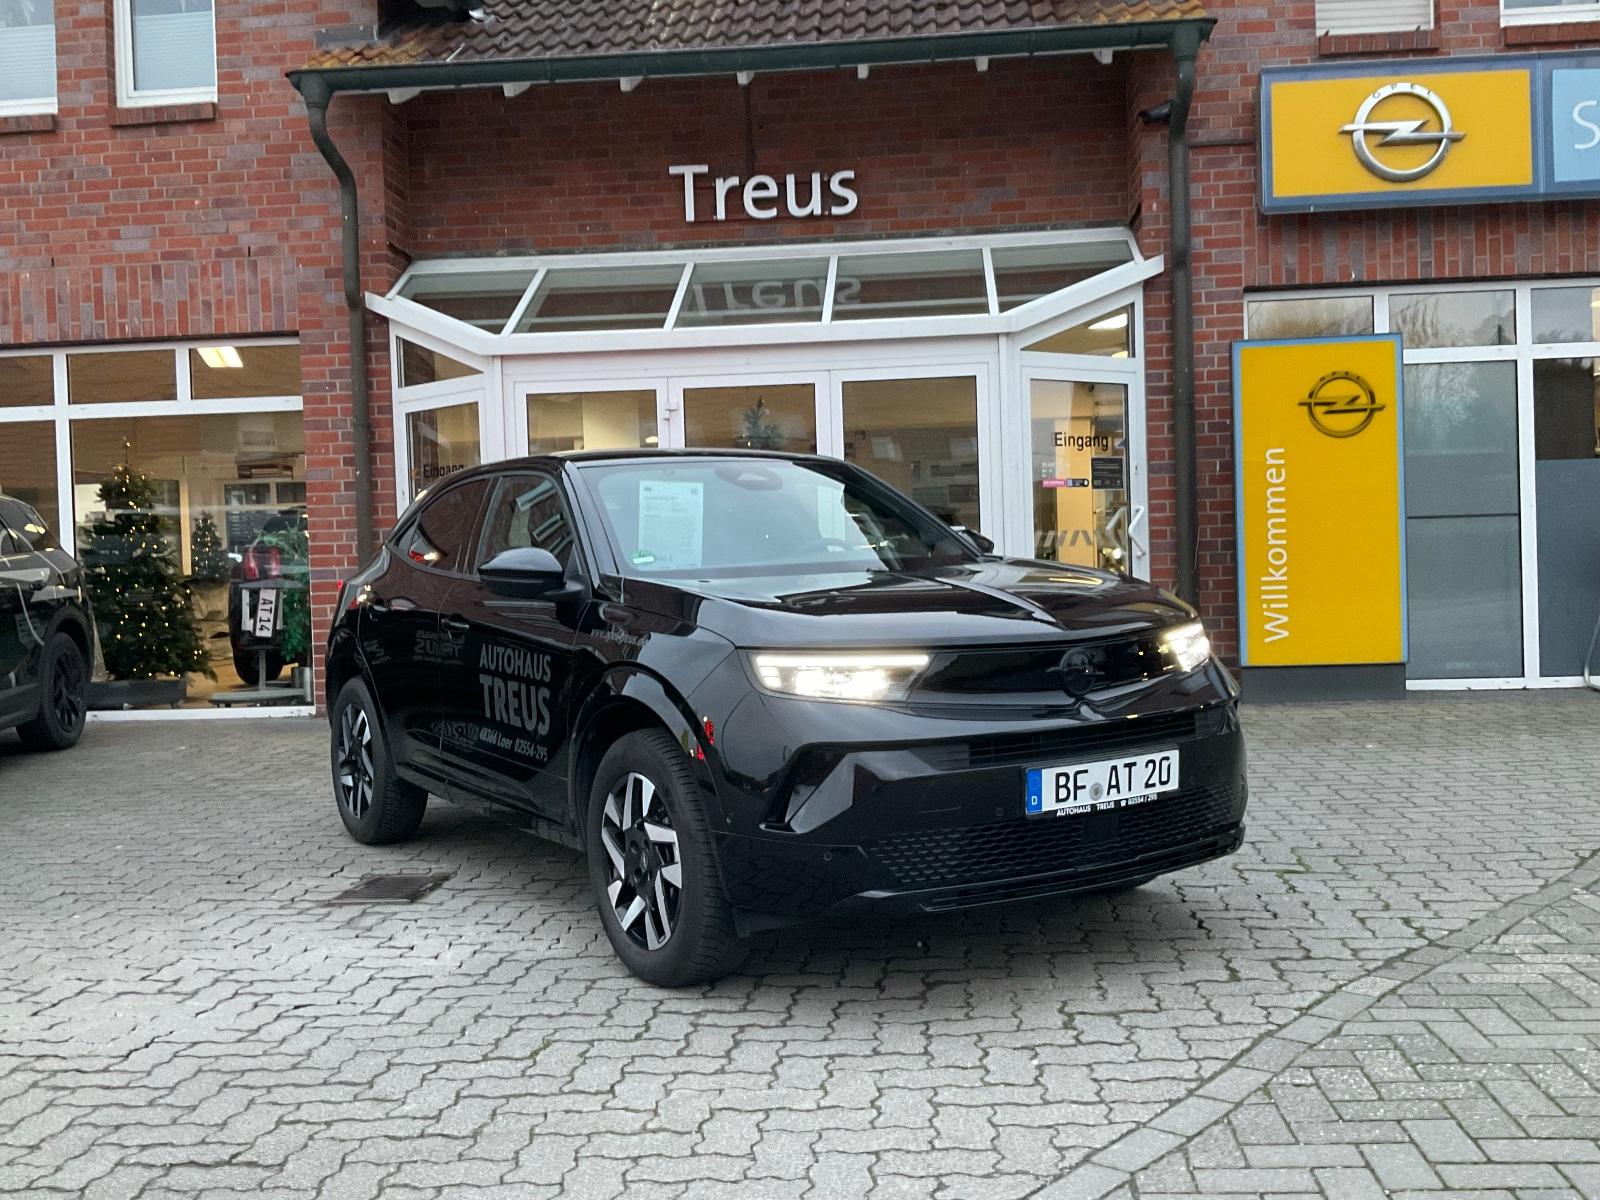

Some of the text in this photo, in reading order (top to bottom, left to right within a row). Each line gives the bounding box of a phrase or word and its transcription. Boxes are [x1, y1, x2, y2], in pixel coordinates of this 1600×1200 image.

[1372, 83, 1432, 99] OPEL
[668, 164, 858, 223] Treus
[1053, 431, 1109, 452] Eingang
[1260, 447, 1290, 643] Willkommen
[479, 643, 551, 683] AUTOHAUS
[479, 673, 551, 736] TREUS
[1055, 756, 1171, 803] BF AT 20
[1031, 795, 1038, 805] D
[1056, 804, 1092, 817] AUTOHAUS
[1096, 801, 1115, 812] TREUS
